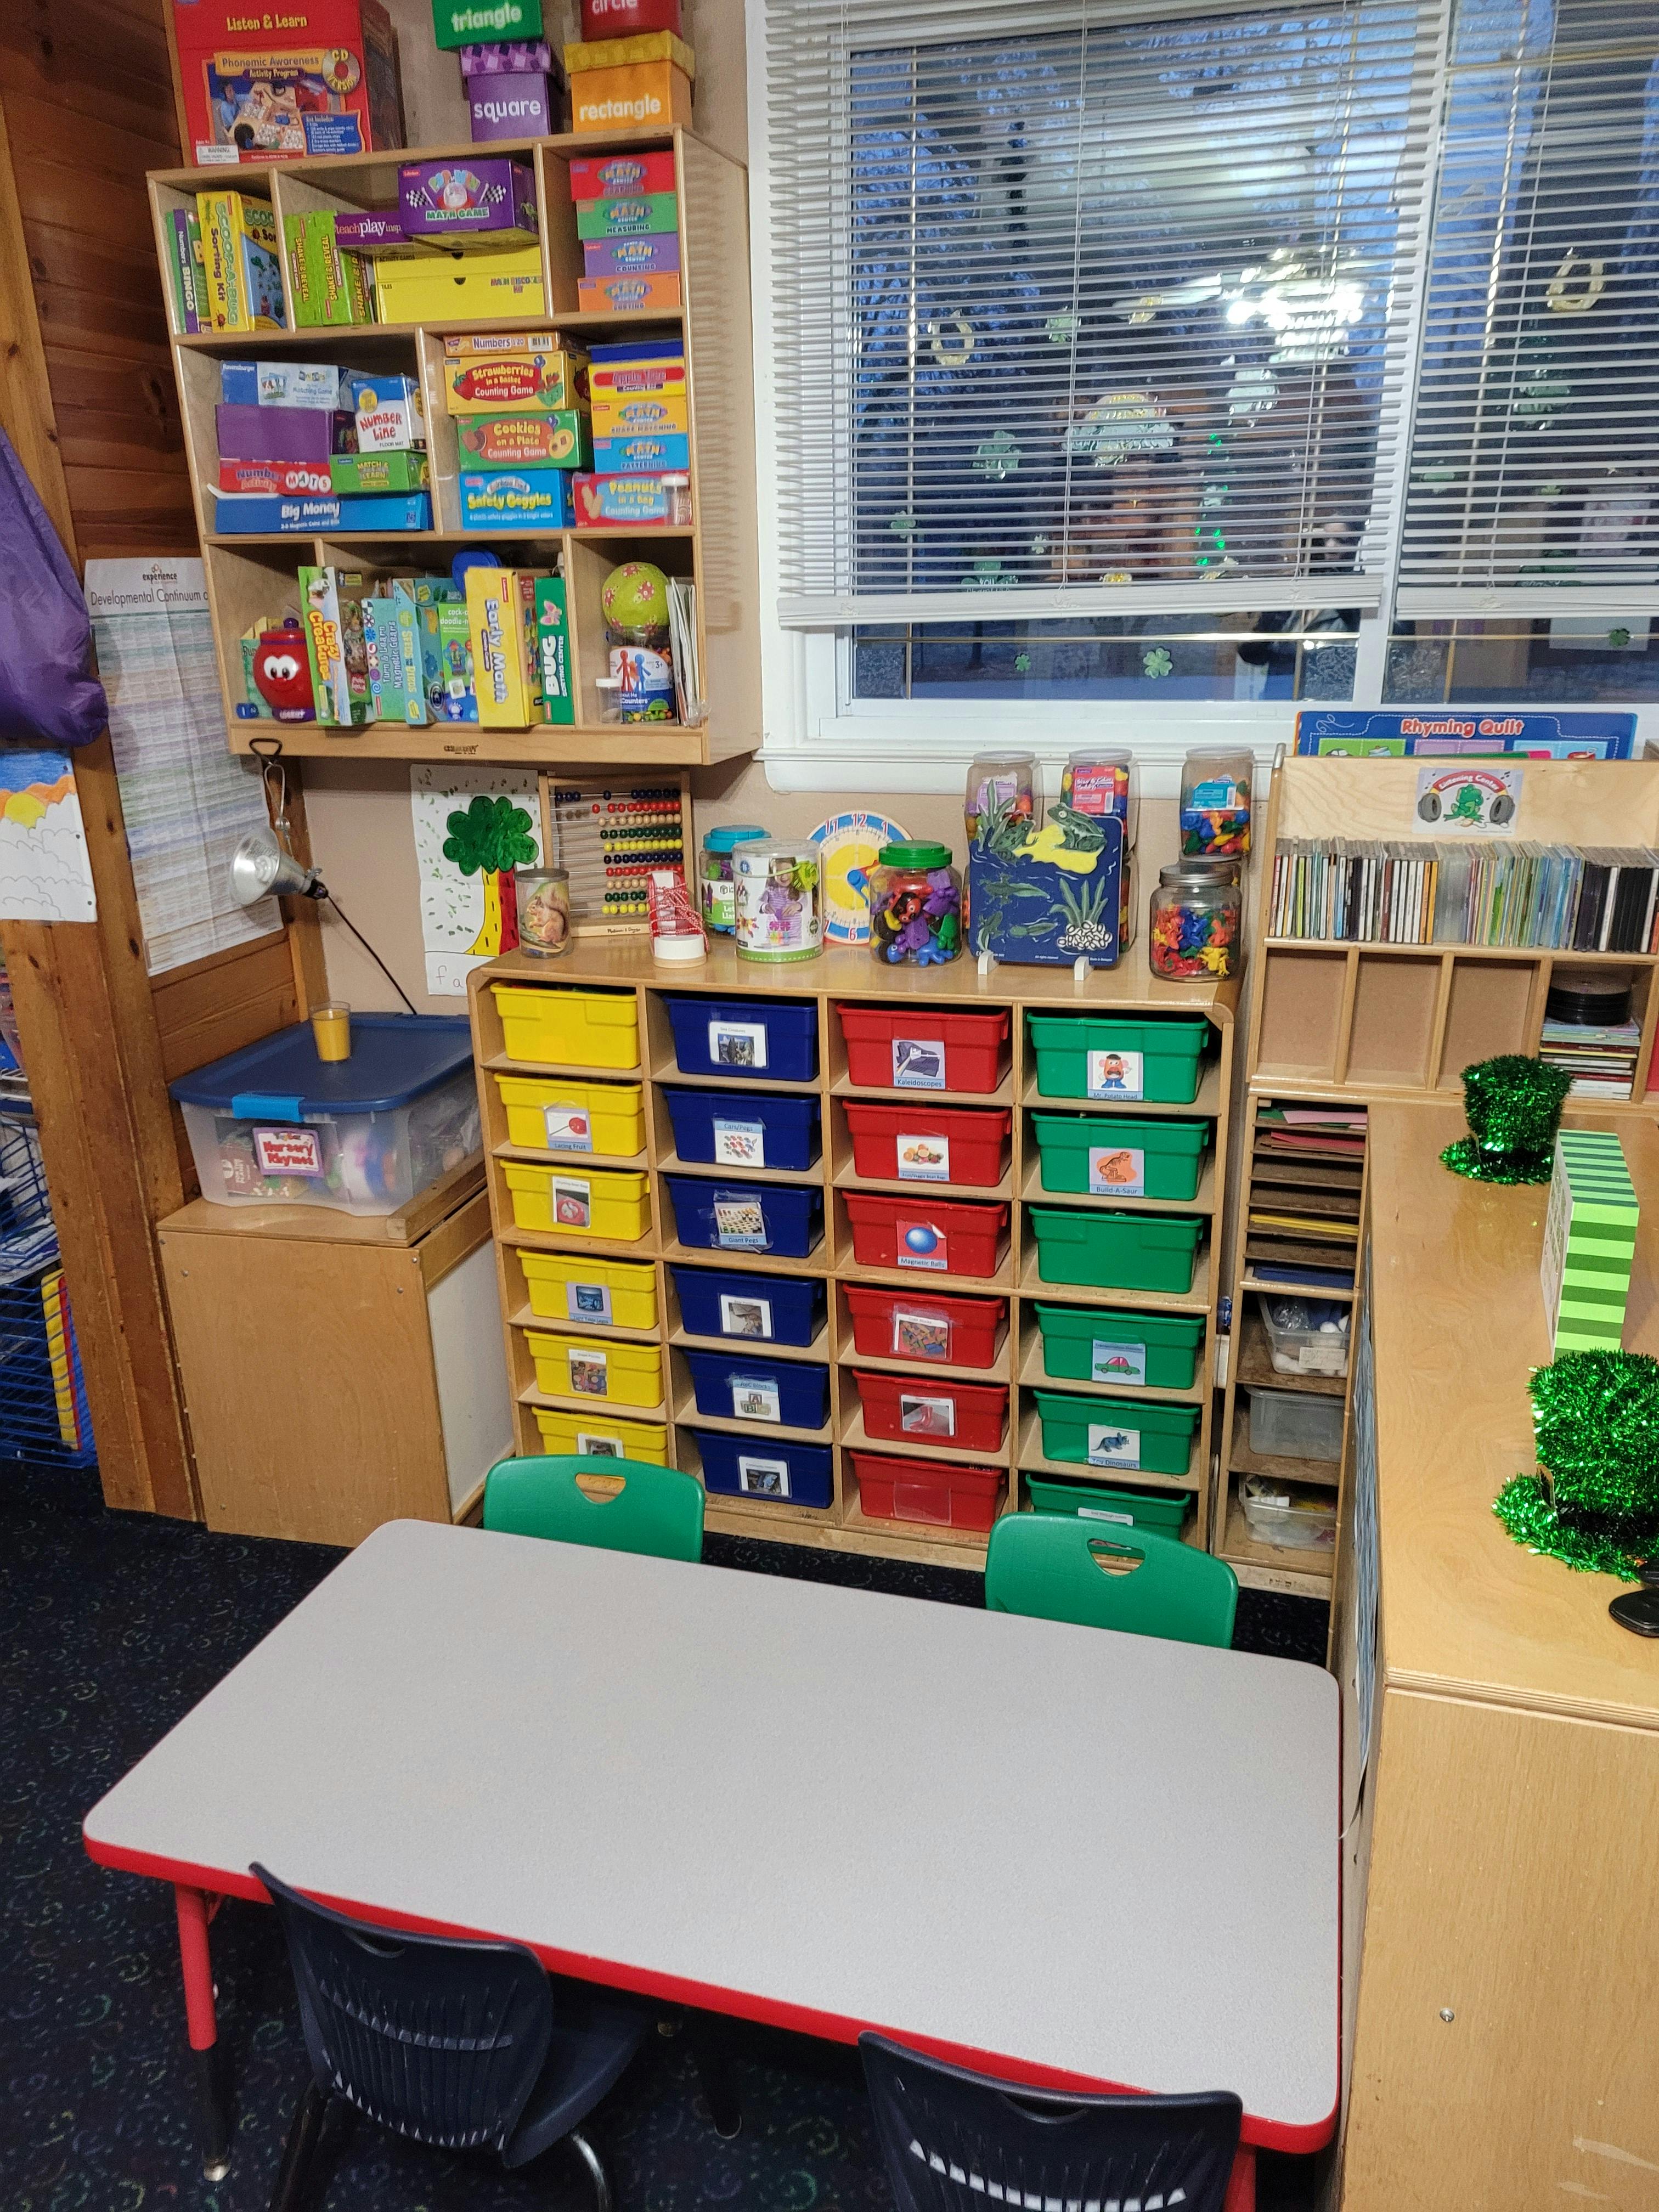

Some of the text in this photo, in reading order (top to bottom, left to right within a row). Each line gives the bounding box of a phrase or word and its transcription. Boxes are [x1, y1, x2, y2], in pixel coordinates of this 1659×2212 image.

[227, 14, 307, 31] Listen & Learn
[452, 5, 522, 32] triangle
[222, 56, 319, 68] Phonemic Awareness
[331, 49, 348, 61] CD
[249, 69, 299, 79] Activity Program
[329, 74, 356, 91] VERSION
[473, 100, 541, 122] square
[579, 94, 661, 121] rectangle
[426, 206, 490, 221] MATH GAME
[610, 205, 645, 219] MATH
[336, 217, 387, 237] teach play
[607, 224, 650, 234] MEASURING
[295, 237, 306, 263] SHAKE
[321, 235, 332, 264] REVEAL
[617, 246, 652, 259] MATH
[178, 230, 194, 311] Numbers BINGO
[211, 228, 225, 301] Sorting Kit
[216, 202, 239, 326] SCOOP-A-BUG
[616, 263, 656, 272] COUNTING
[300, 272, 309, 303] REVEAL
[326, 274, 337, 301] SHAKE
[354, 267, 366, 317] SHAKE &
[473, 337, 511, 348] Numbers
[223, 364, 255, 373] Ravensburger
[472, 364, 534, 381] Strawberries
[499, 376, 521, 385] Basket
[475, 386, 534, 397] Counting Game
[493, 421, 541, 437] Cookies
[496, 438, 507, 447] on
[516, 436, 540, 446] Plate
[487, 447, 547, 459] Counting Game
[357, 461, 381, 471] MATCH
[241, 477, 278, 493] Activity
[287, 472, 329, 490] MATS
[467, 491, 552, 510] Safety Goggles
[281, 501, 340, 522] Big Money
[605, 506, 640, 516] Counting
[142, 572, 178, 584] experience
[91, 588, 201, 608] Developmental Continuum
[309, 611, 341, 681] Crazy Creatures
[485, 599, 509, 704] Early Math
[389, 621, 403, 689] Magnetic Gears
[542, 635, 560, 696] BUG
[655, 661, 663, 669] 3+
[559, 664, 567, 697] SORTING
[1401, 718, 1525, 738] Rhyming Quilt
[1438, 775, 1500, 791] Listening Center
[826, 819, 838, 834] 11
[853, 813, 866, 827] 12
[882, 821, 888, 834] 1
[849, 927, 857, 941] 6
[898, 1079, 943, 1088] Kaleidoscopes
[724, 1123, 753, 1132] Cars/Pegs
[263, 1141, 313, 1156] Nursery
[267, 1153, 314, 1167] Rhymes
[1105, 1459, 1137, 1468] Dinosaurs
